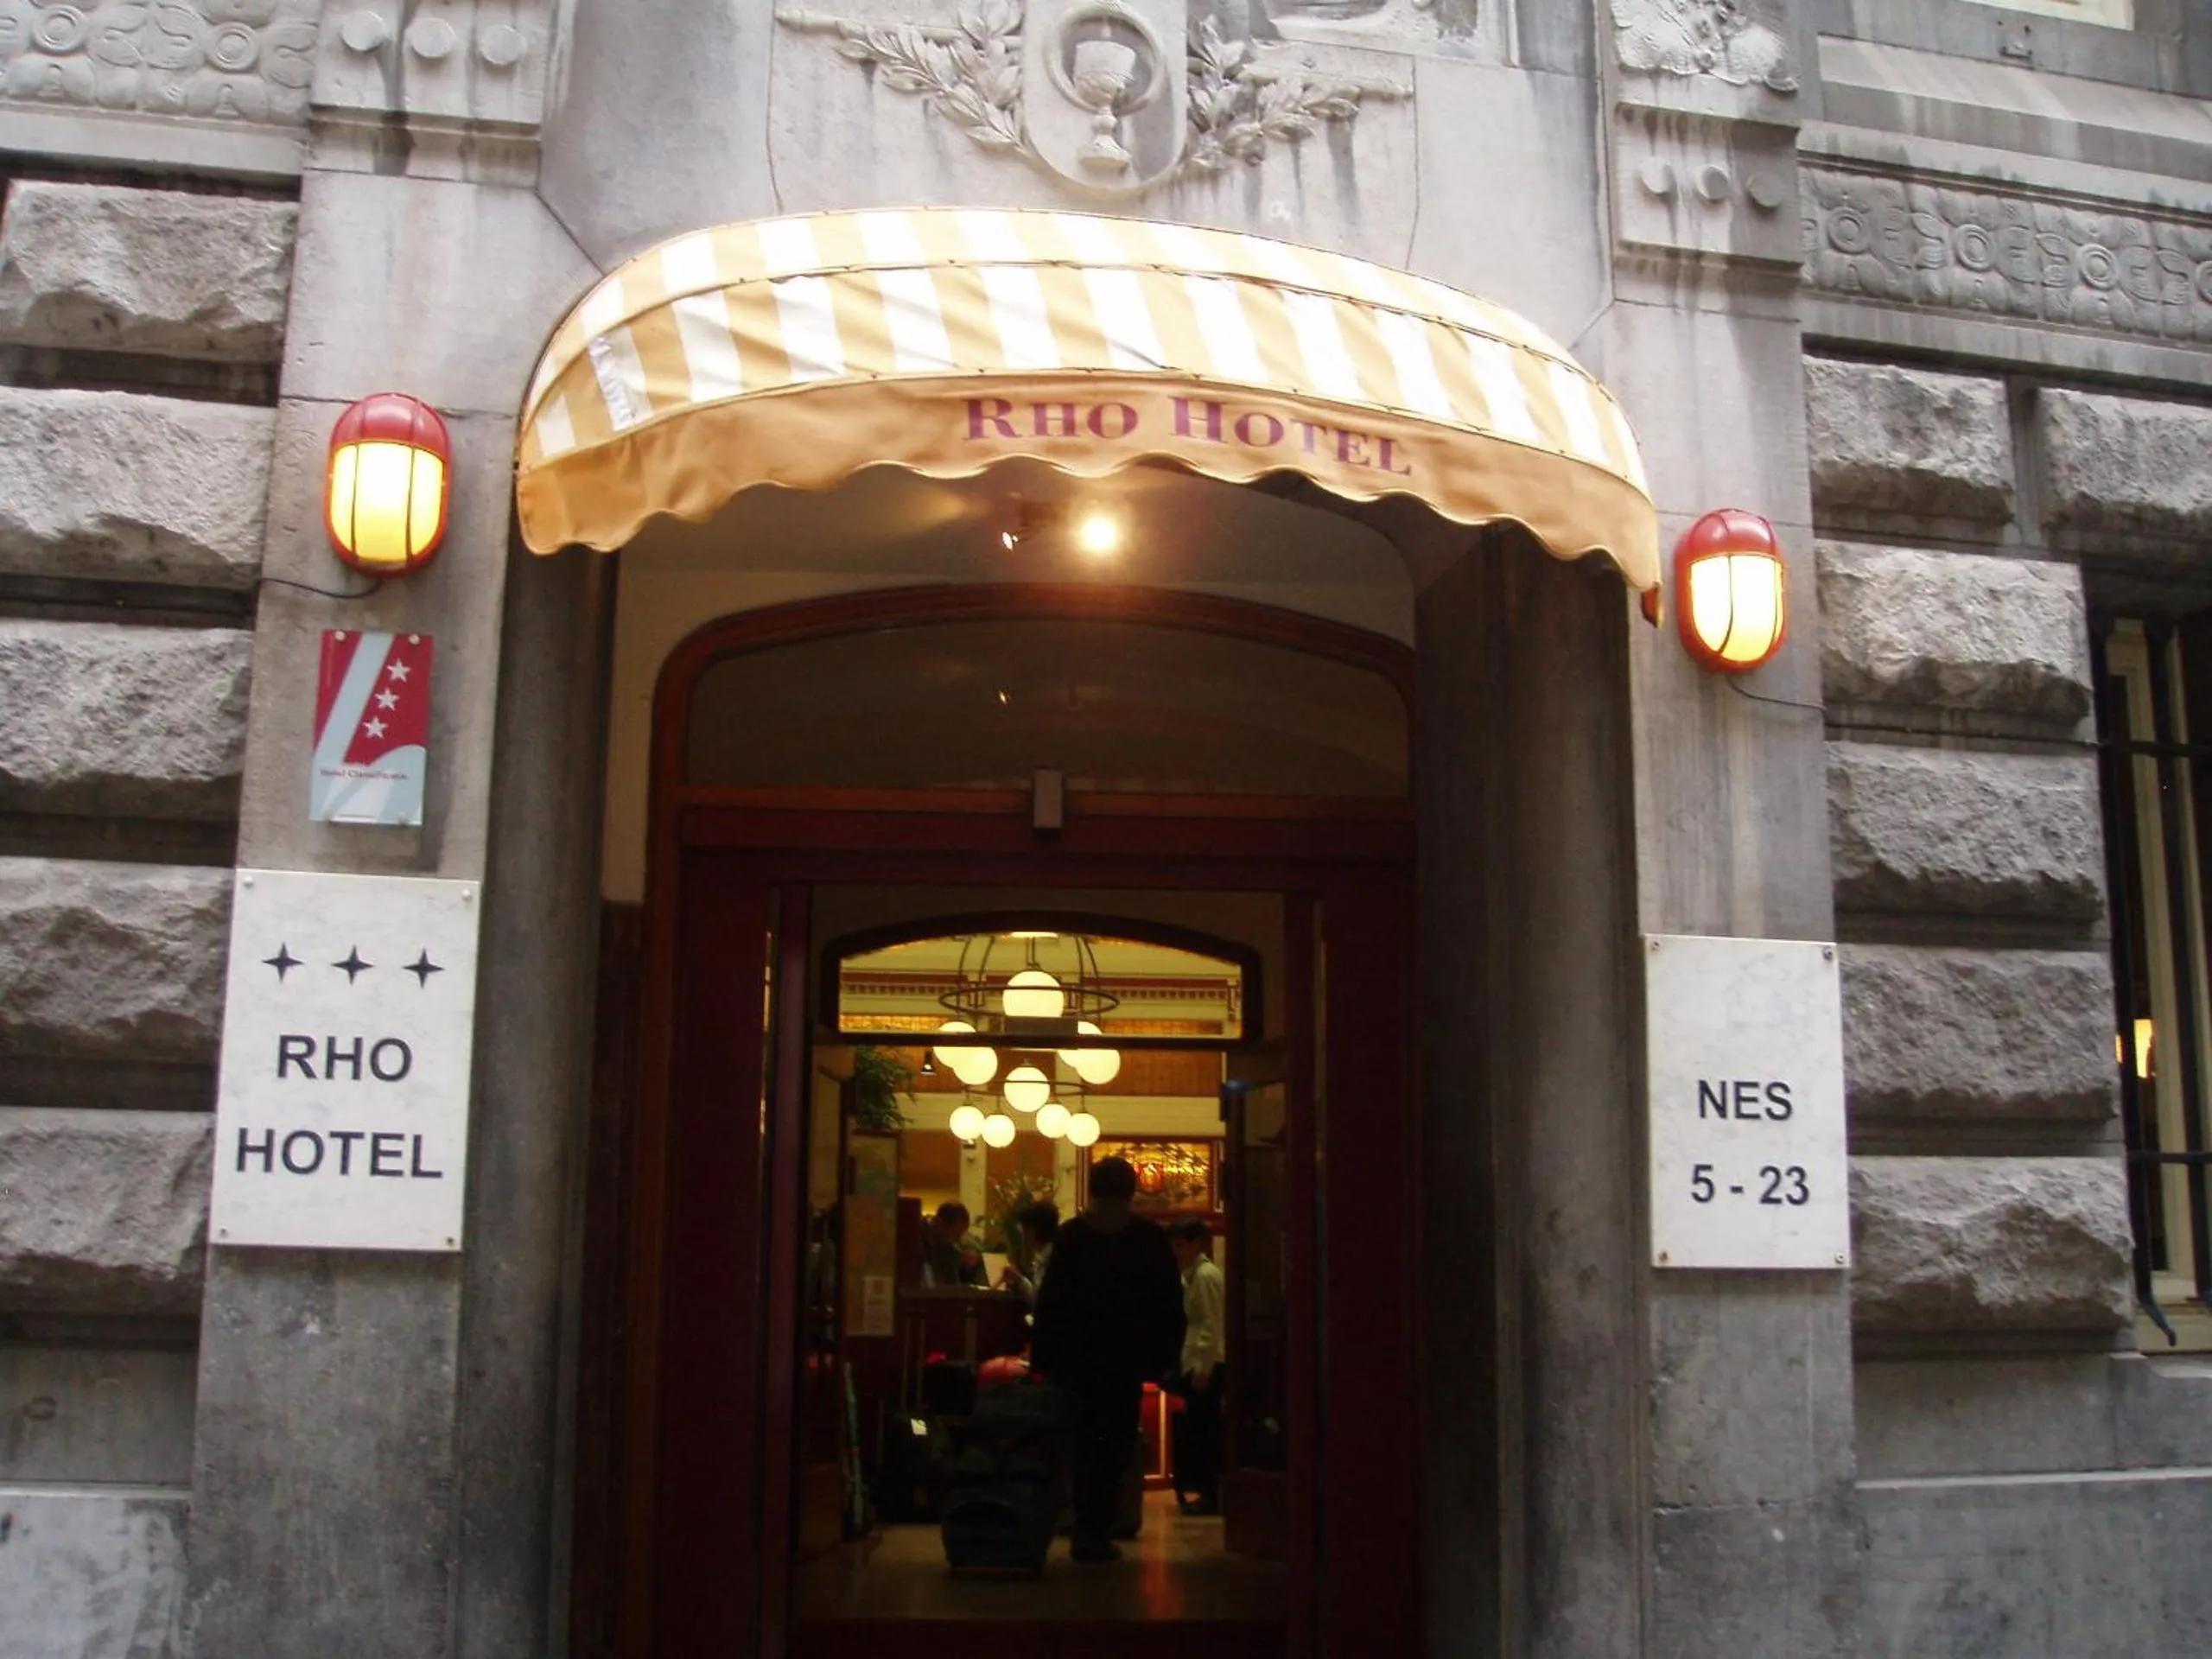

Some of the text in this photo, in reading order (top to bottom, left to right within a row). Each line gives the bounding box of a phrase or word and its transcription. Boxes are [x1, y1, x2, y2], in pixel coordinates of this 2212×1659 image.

[963, 397, 1413, 476] RHO HOTEL
[276, 1034, 413, 1083] RHO
[1697, 1079, 1794, 1122] NES
[236, 1128, 443, 1179] HOTEL
